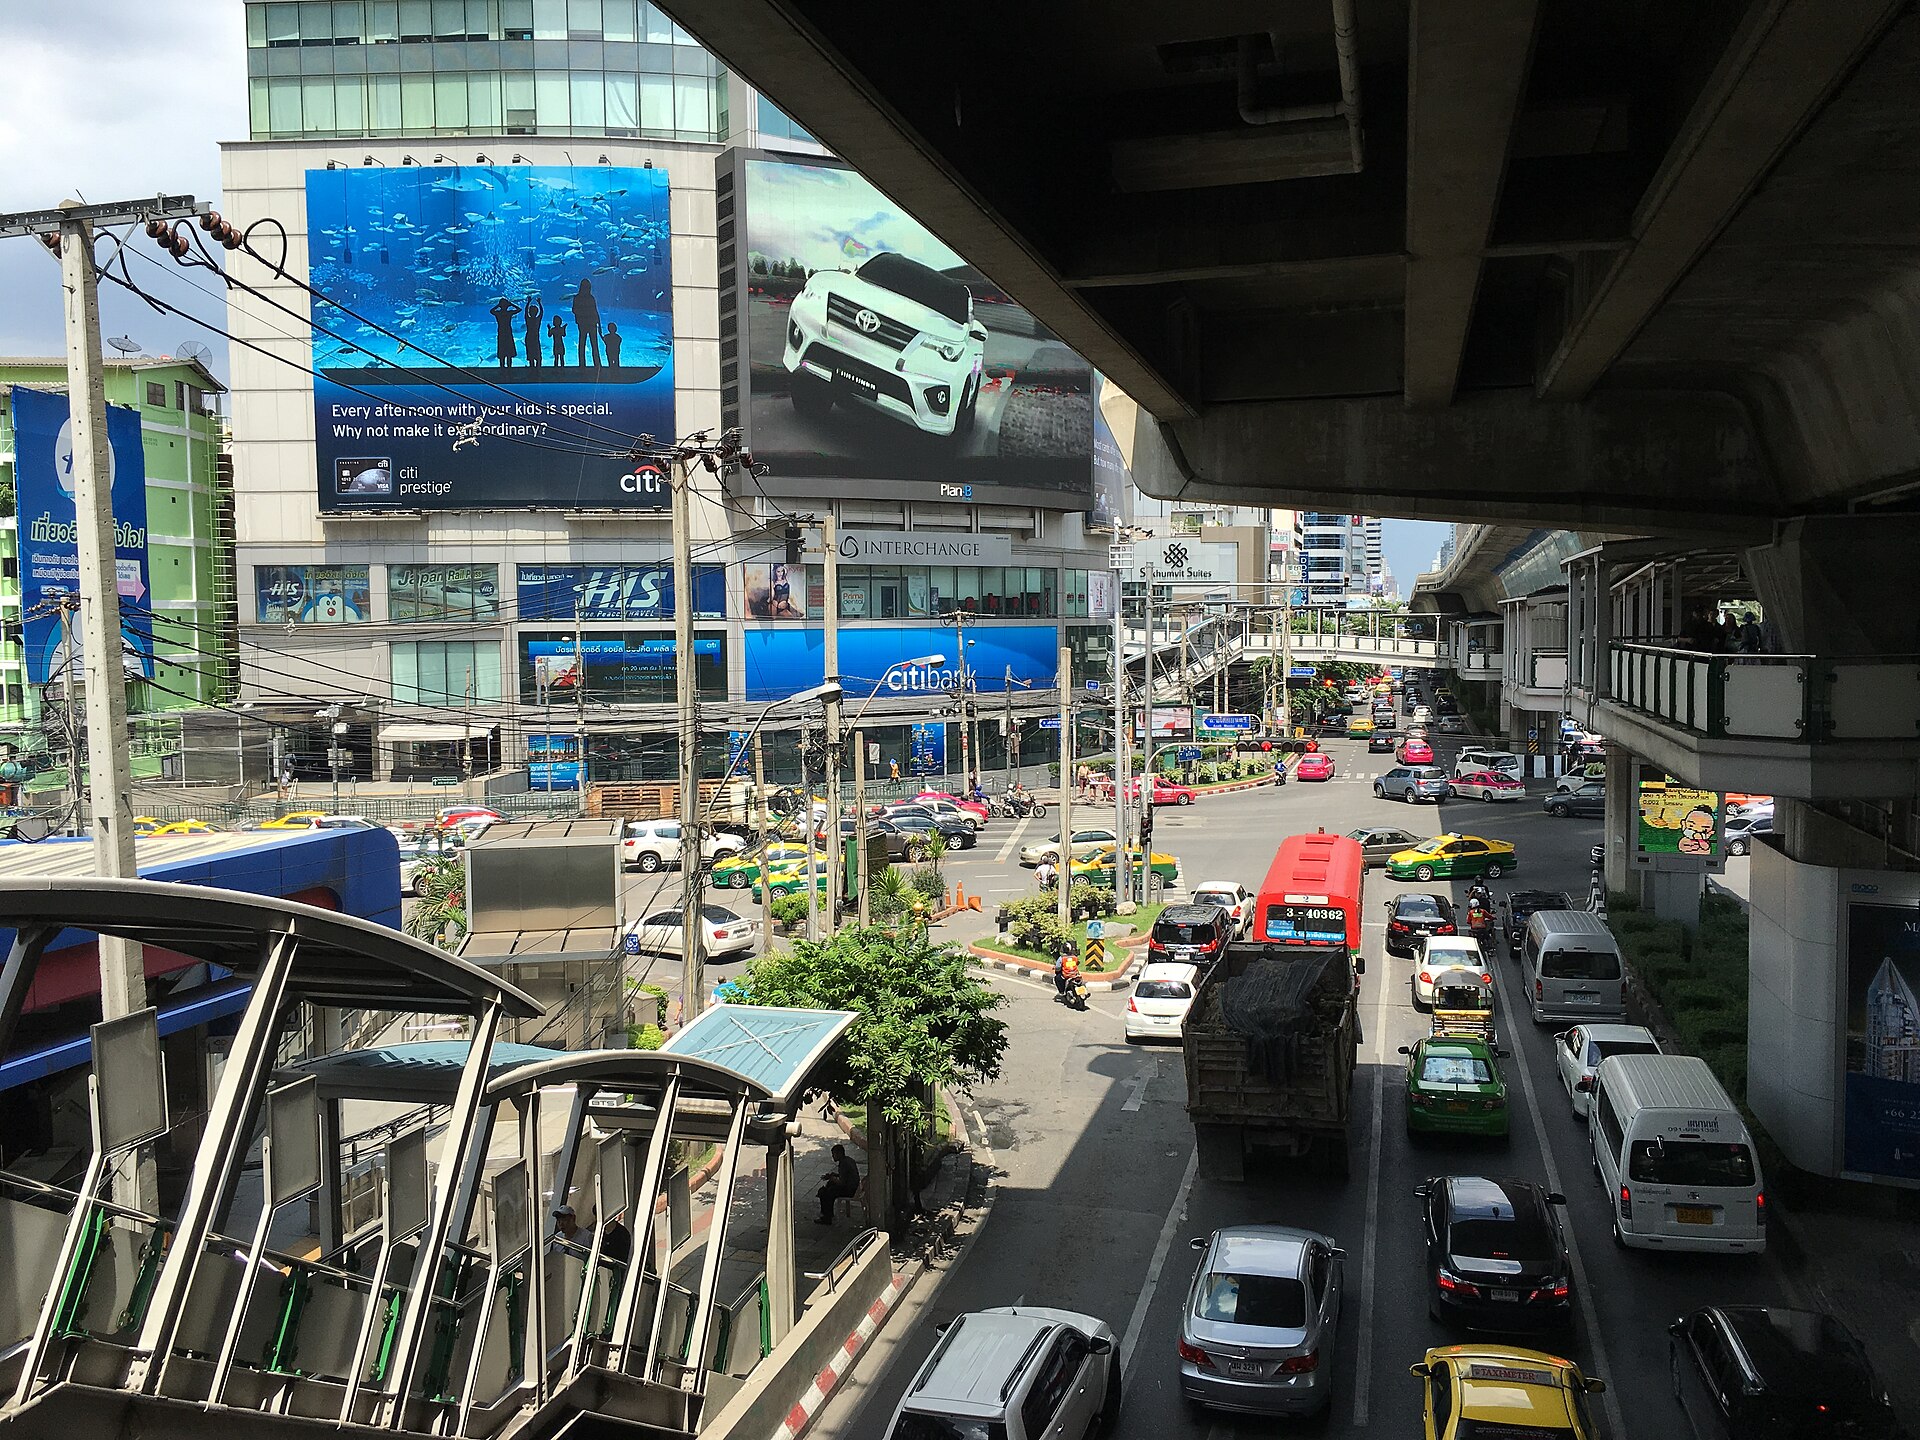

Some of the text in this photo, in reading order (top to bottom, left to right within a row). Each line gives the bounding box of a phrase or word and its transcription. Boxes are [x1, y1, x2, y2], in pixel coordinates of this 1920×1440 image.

[332, 402, 613, 419] Every afternoon with your kids is special.
[332, 424, 362, 440] Why
[366, 424, 389, 437] not
[393, 424, 430, 437] make
[434, 424, 443, 437] it
[377, 460, 389, 468] citi
[400, 467, 418, 479] citi
[400, 481, 451, 496] prestige
[621, 470, 660, 493] citi
[864, 540, 980, 557] INTERCHANGE
[398, 569, 482, 587] Japan Rail Pss
[1186, 567, 1212, 578] Suites
[843, 592, 864, 600] Prima
[887, 664, 977, 692] citibank
